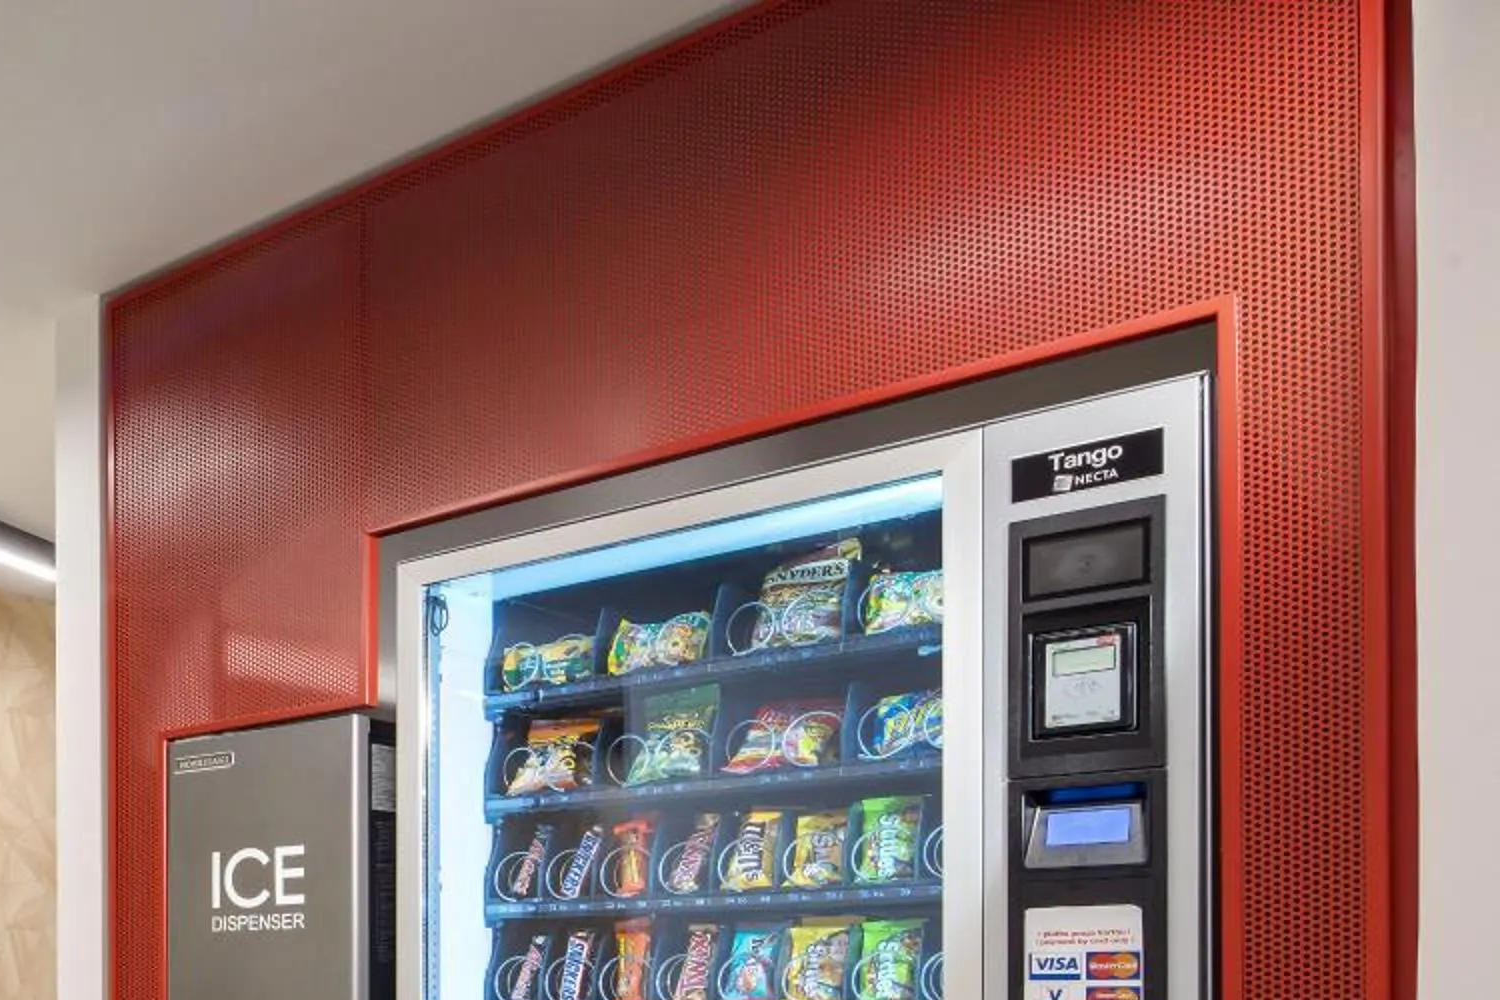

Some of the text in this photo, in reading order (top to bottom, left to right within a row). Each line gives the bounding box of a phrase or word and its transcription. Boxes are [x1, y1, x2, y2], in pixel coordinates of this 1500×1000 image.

[1048, 445, 1123, 472] Tango
[1075, 468, 1119, 486] NECTA
[211, 844, 305, 909] ICE
[212, 913, 305, 932] DISPENSER
[1035, 957, 1078, 971] VISA
